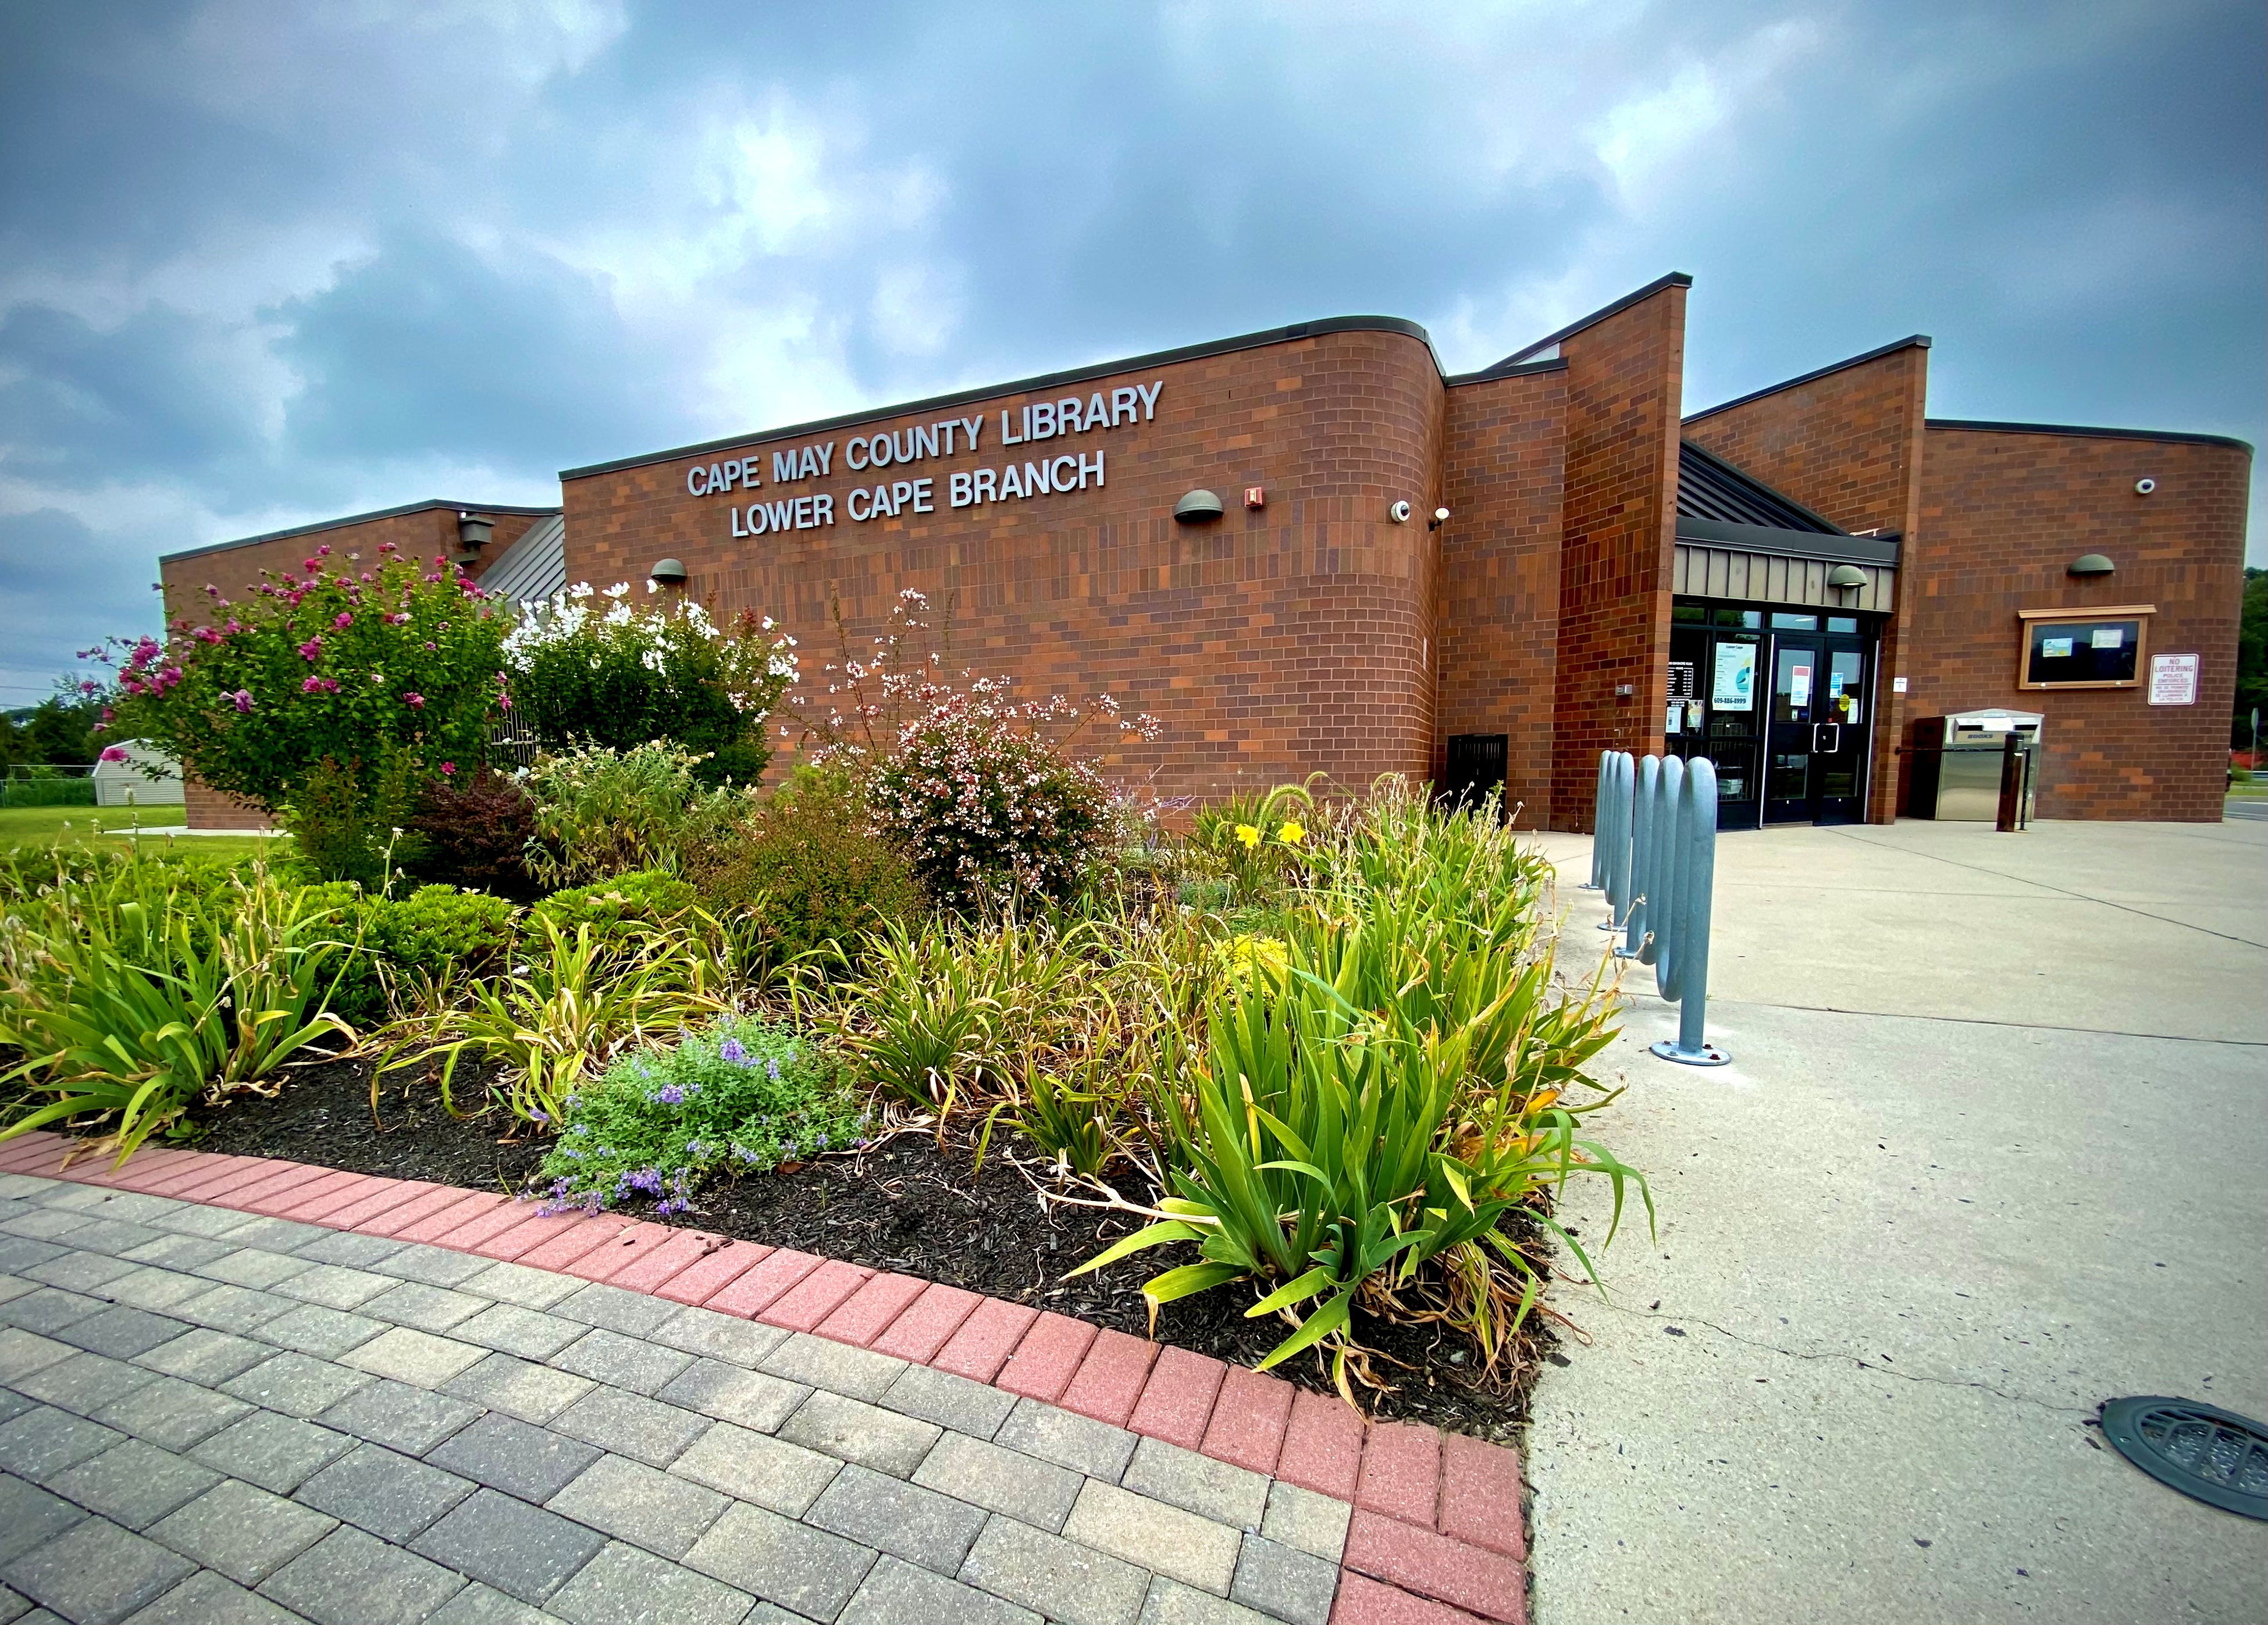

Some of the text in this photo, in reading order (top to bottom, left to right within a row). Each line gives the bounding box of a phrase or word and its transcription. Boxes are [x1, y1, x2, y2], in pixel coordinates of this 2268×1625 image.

[688, 380, 1163, 497] CAPE MAY COUNTY LIBRARY
[731, 450, 1105, 538] LOWER CAPE BRANCH
